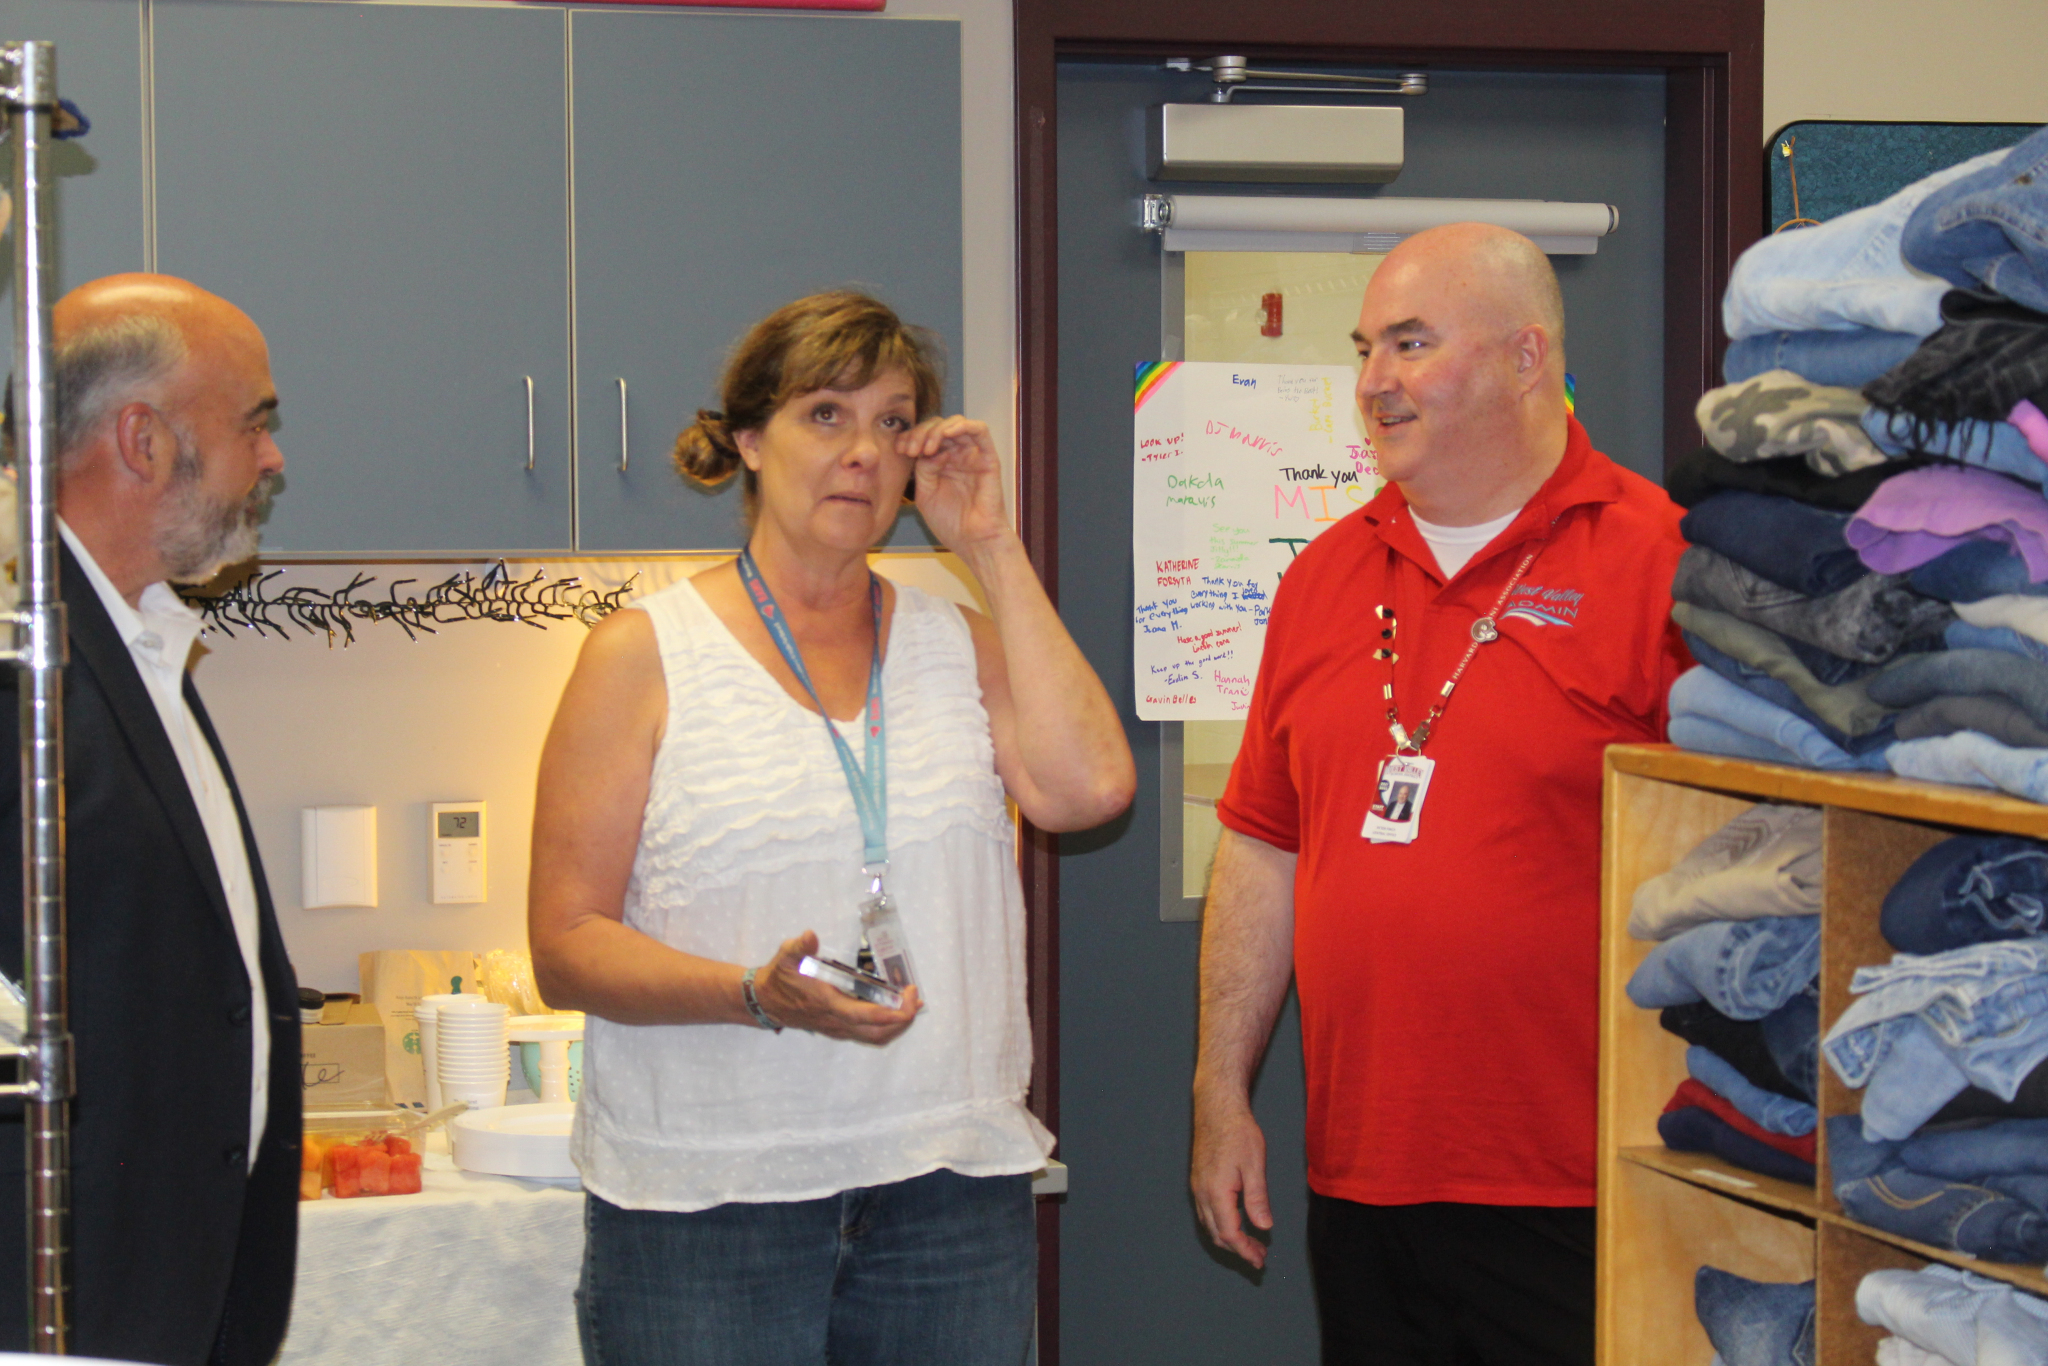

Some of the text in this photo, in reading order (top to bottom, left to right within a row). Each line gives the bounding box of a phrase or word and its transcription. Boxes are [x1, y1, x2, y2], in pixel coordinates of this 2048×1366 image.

[1233, 374, 1256, 389] Evan
[1279, 464, 1358, 488] Thank you
[1156, 558, 1200, 573] KATHERINE
[1202, 577, 1225, 586] Thank
[1497, 554, 1534, 606] ASSOCIATION
[1542, 588, 1585, 607] Valley
[1506, 600, 1578, 618] ADMIN
[1452, 641, 1479, 680] HARVARD
[1214, 670, 1250, 686] Hannah
[453, 816, 467, 829] 72
